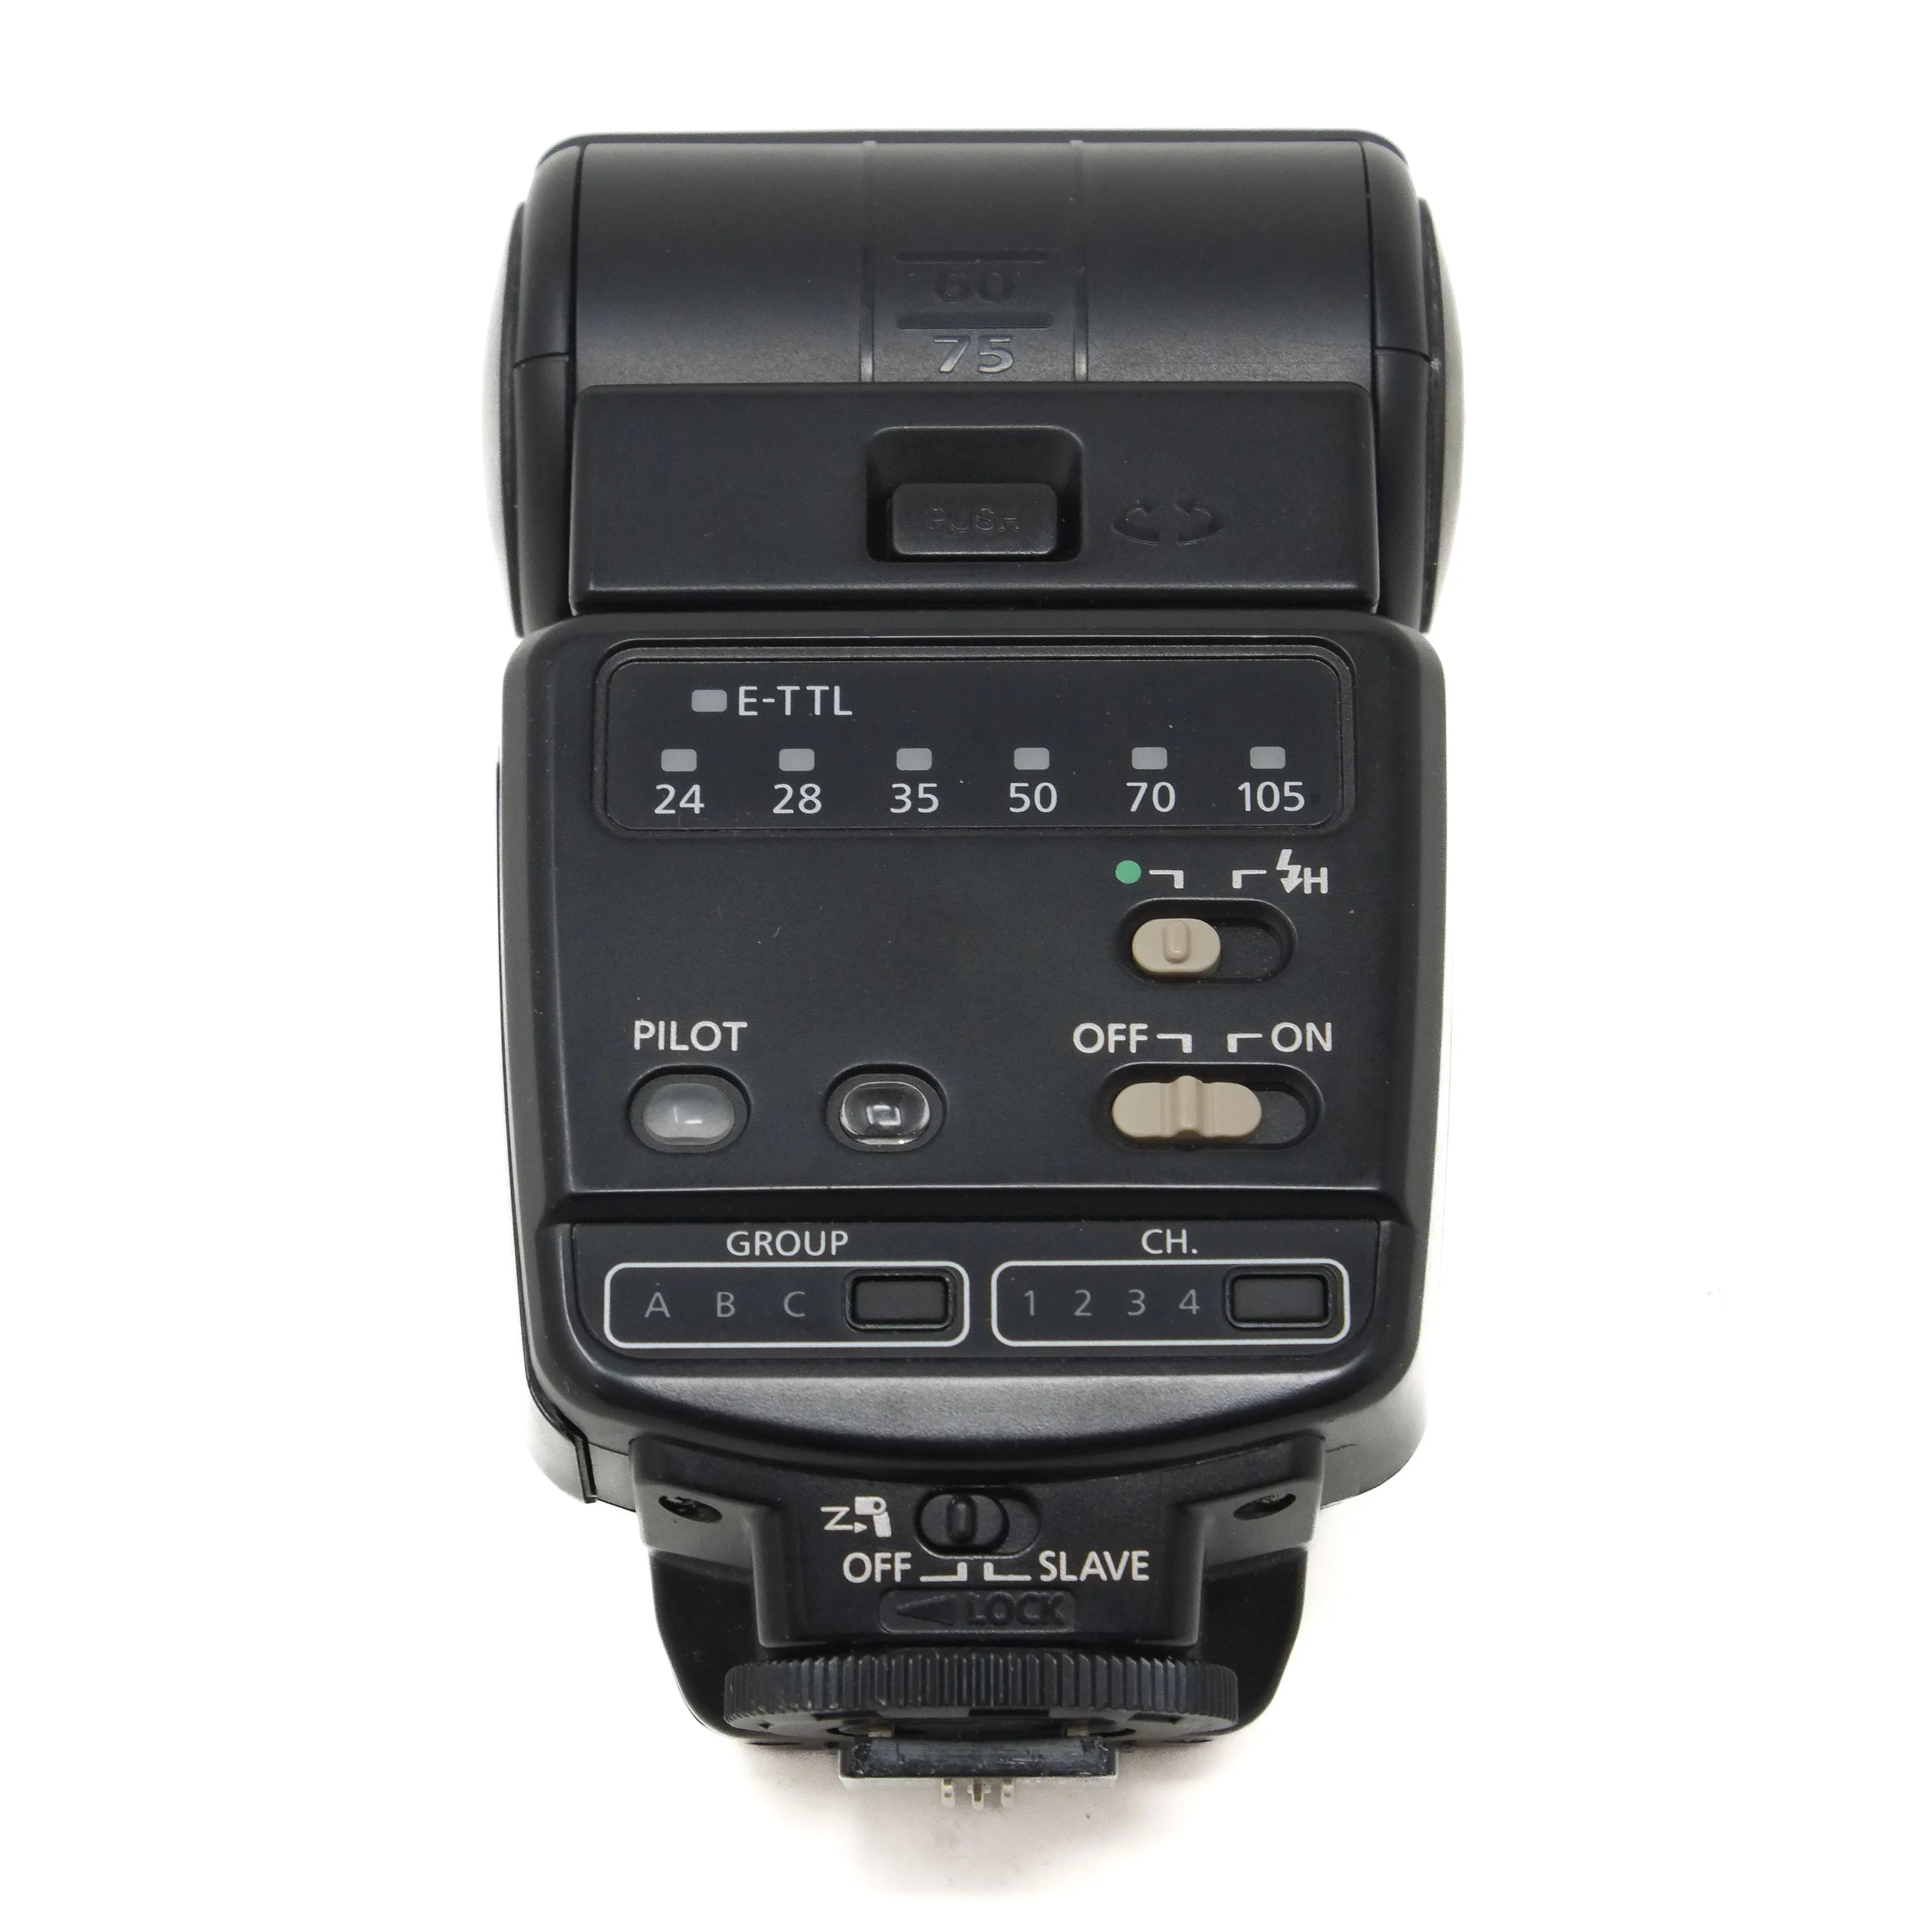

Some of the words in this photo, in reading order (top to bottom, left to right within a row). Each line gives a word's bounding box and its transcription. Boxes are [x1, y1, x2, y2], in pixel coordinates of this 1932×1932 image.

[933, 335, 1014, 373] 75
[929, 507, 1020, 533] PUSH
[738, 685, 853, 716] E-TTL
[654, 784, 705, 815] 24
[772, 784, 822, 814] 28
[890, 783, 939, 814] 35
[1009, 782, 1058, 813] 50
[1126, 781, 1176, 813] 70
[1238, 781, 1305, 812] 105
[633, 1019, 748, 1052] PILOT
[1073, 1022, 1148, 1054] OFF
[1271, 1022, 1332, 1052] ON
[726, 1230, 849, 1257] GROUP
[1141, 1229, 1199, 1254] CH.
[645, 1292, 670, 1318] A
[716, 1291, 736, 1318] B
[783, 1291, 806, 1318] C
[1024, 1290, 1036, 1316] 1
[1074, 1289, 1092, 1316] 2
[1127, 1289, 1147, 1316] 3
[1178, 1289, 1201, 1315] 4
[842, 1551, 912, 1583] OFF
[1039, 1550, 1150, 1582] SLAVE
[966, 1590, 1065, 1625] LOCK
